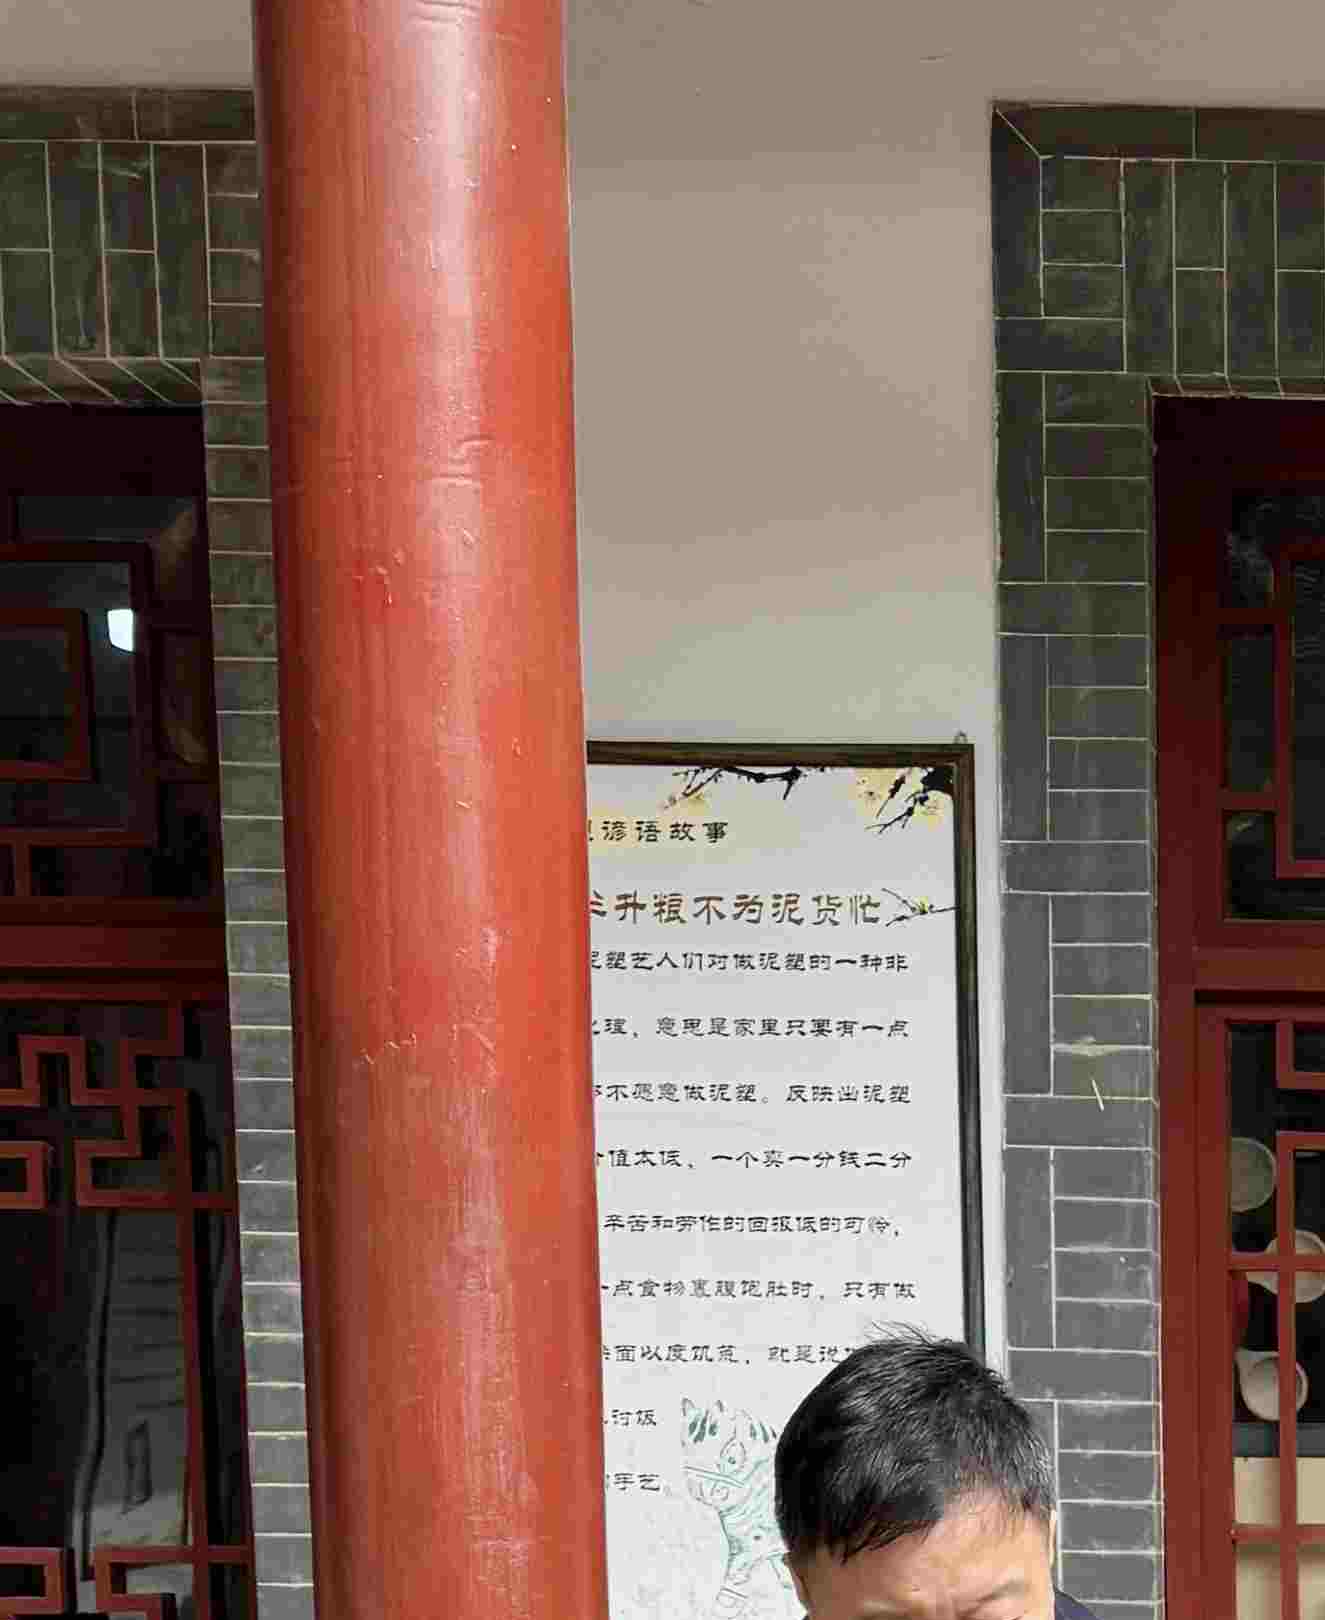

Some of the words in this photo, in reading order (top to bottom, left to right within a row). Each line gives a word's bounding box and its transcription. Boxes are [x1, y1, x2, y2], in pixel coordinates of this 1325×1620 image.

[587, 820, 729, 844] 谚语故事
[593, 1080, 912, 1105] 不愿意做泥塑。反映出泥塑
[602, 1343, 855, 1365] 面以度饥荒，就是说
[602, 1407, 658, 1427] 讨饭
[606, 1473, 672, 1496] 手艺。
